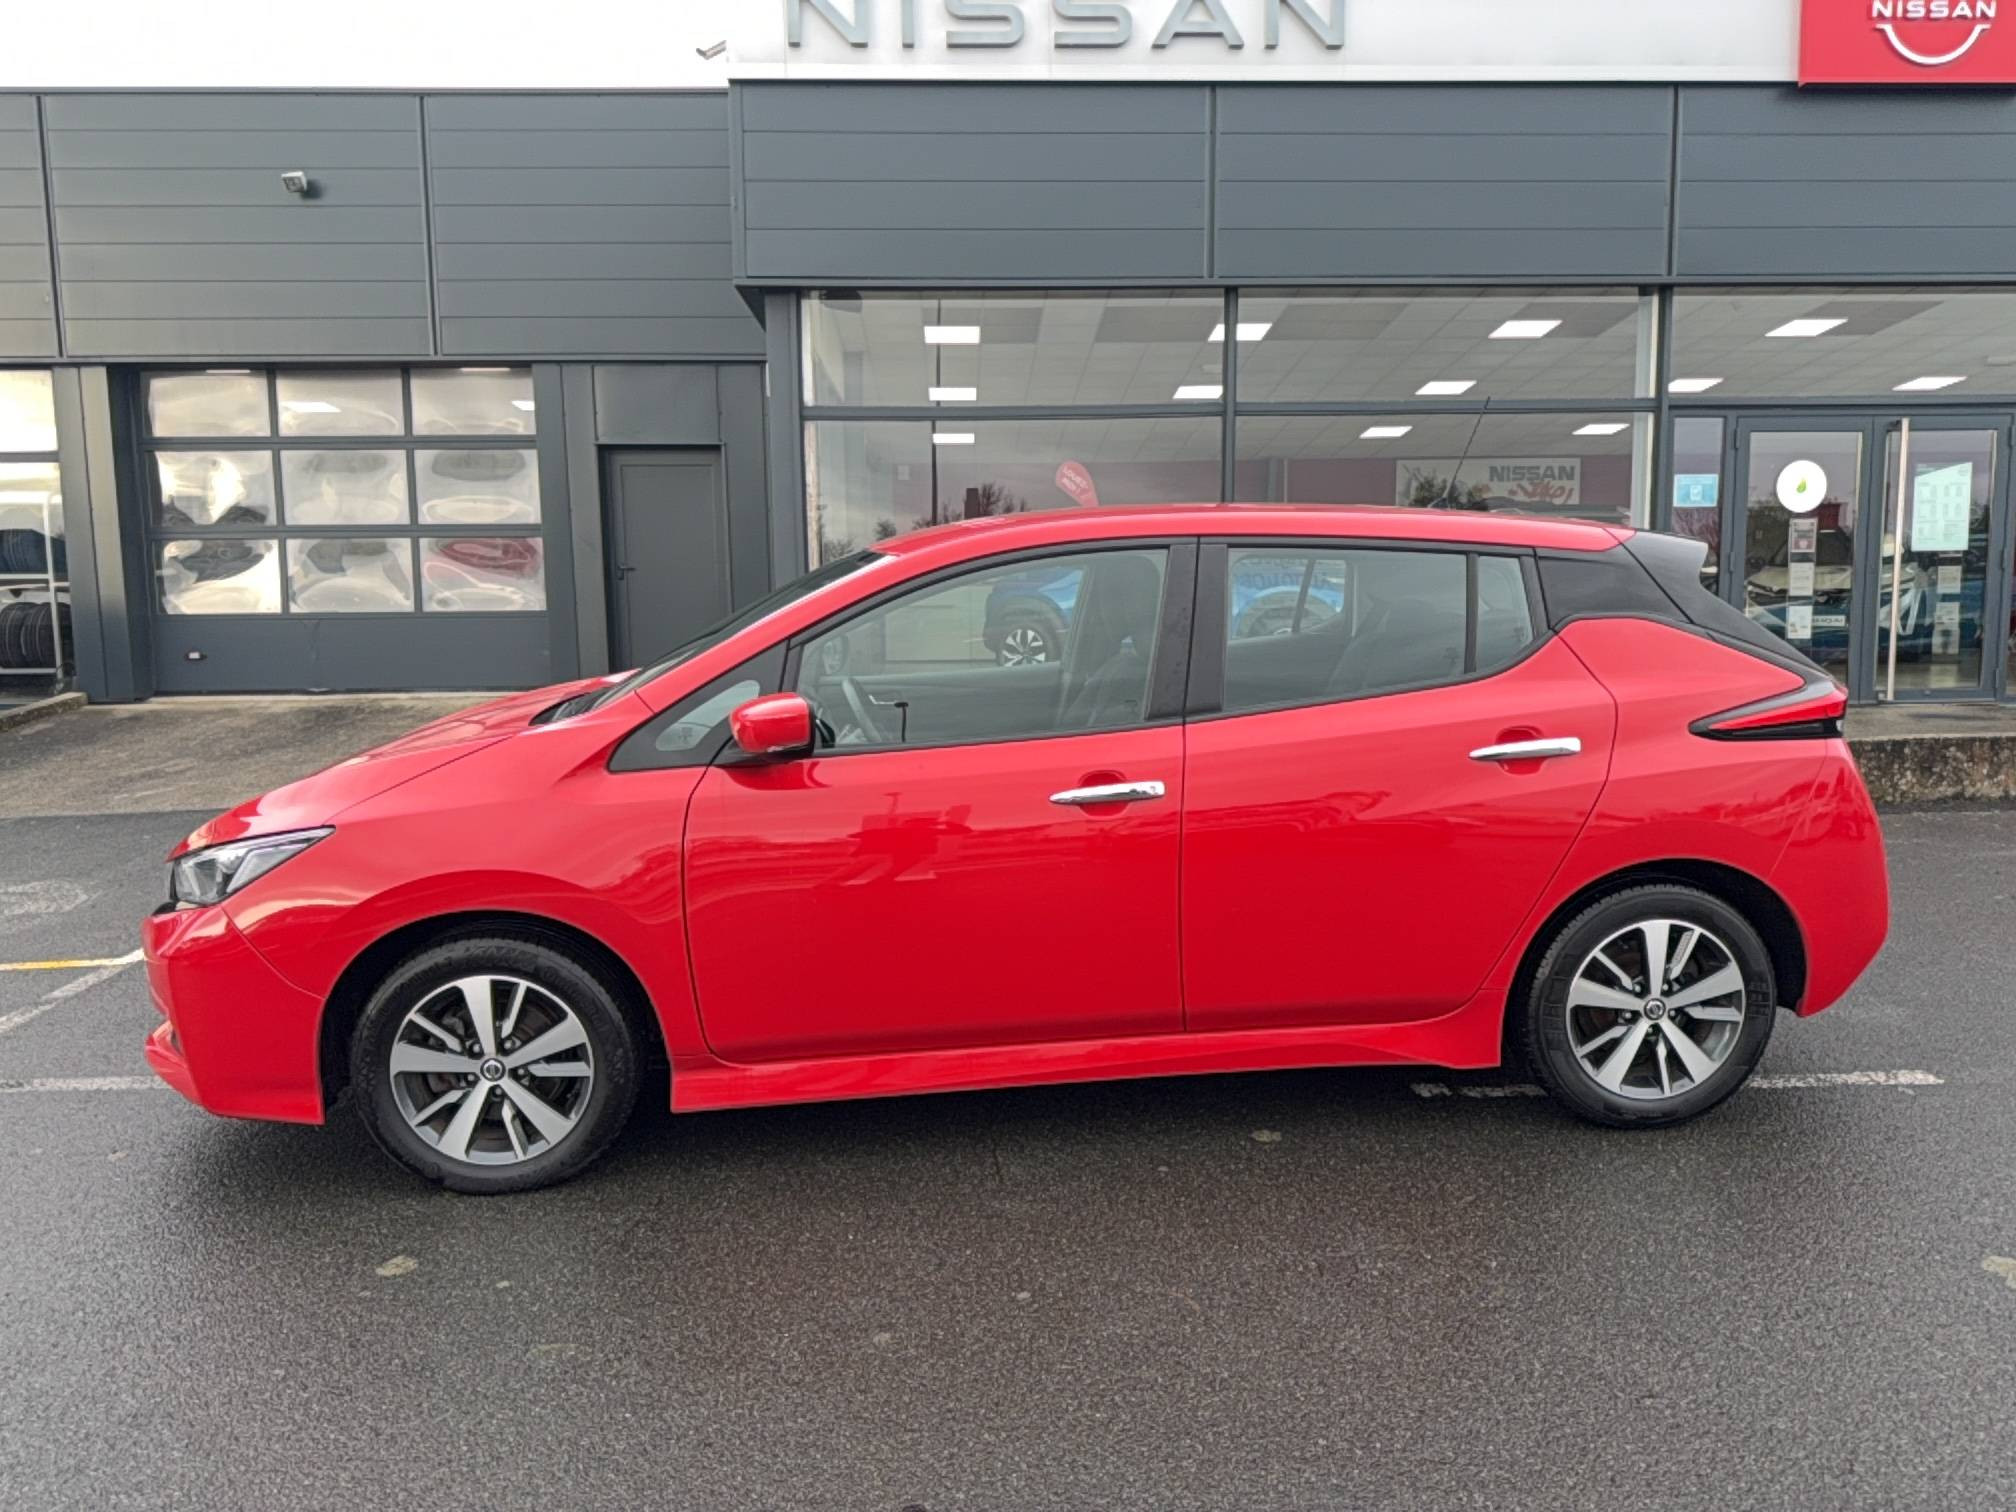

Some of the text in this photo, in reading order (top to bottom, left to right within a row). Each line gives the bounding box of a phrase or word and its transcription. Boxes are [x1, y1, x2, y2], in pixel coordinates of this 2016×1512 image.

[1871, 0, 1997, 18] NISSAN
[787, 0, 1346, 49] NISSAN
[1489, 466, 1575, 482] NISSAN
